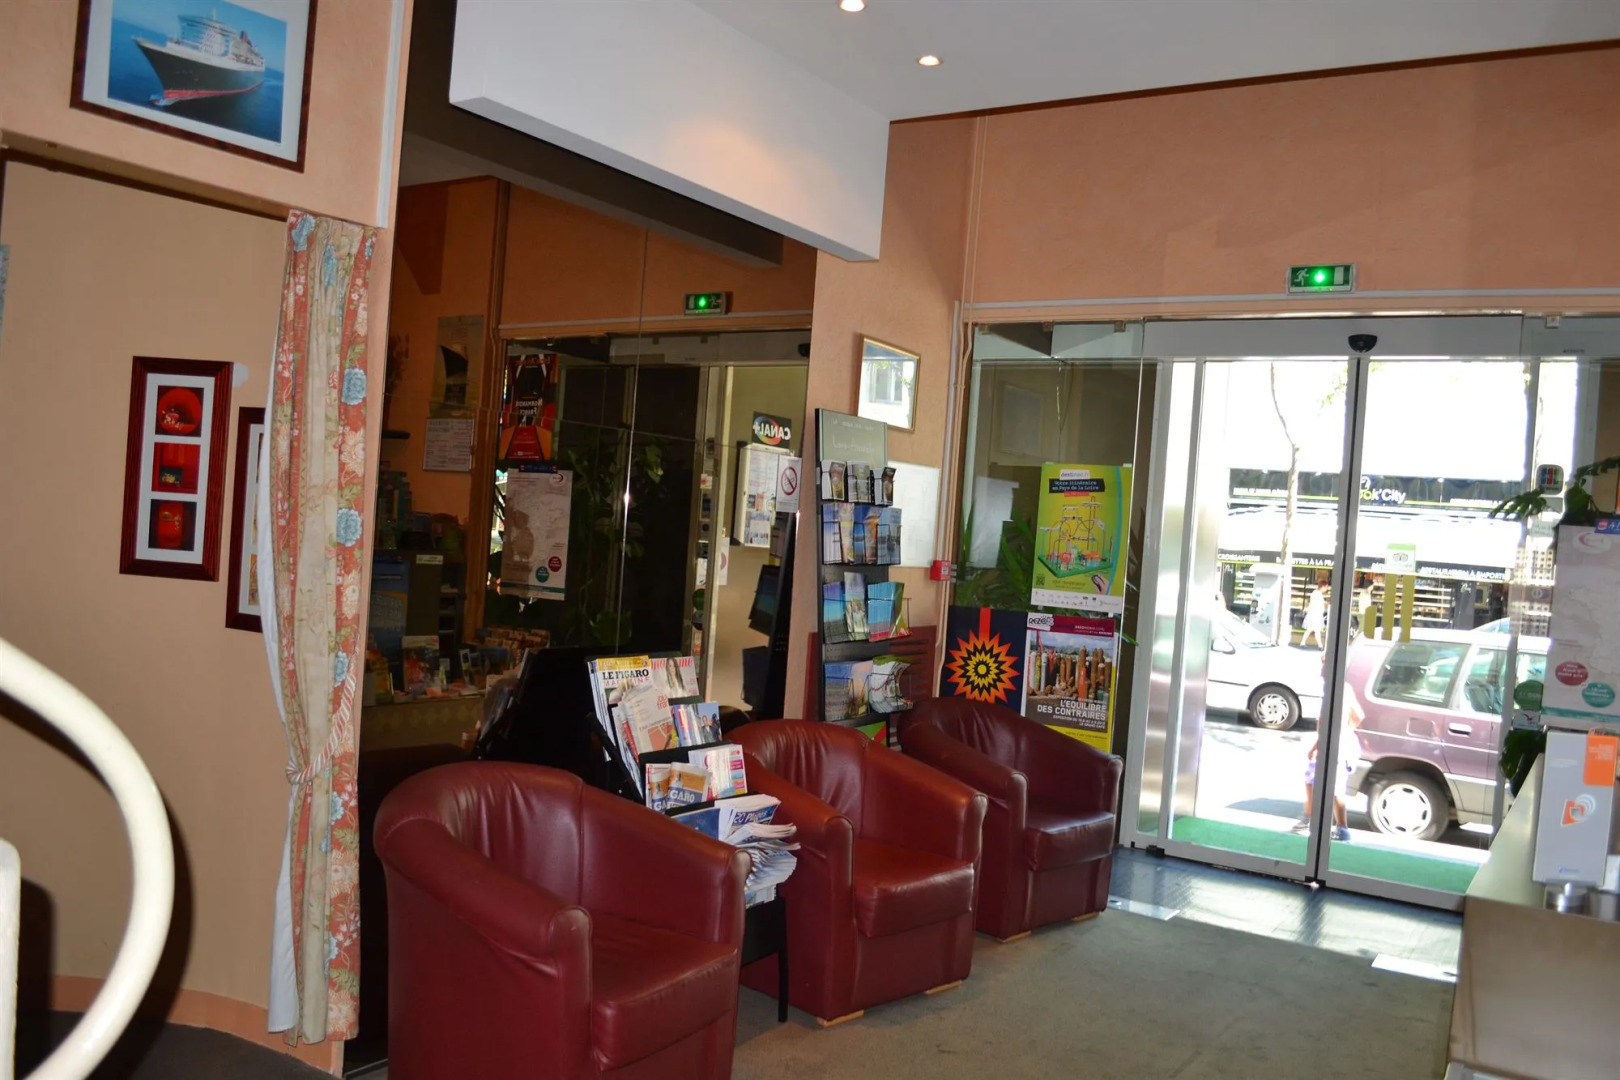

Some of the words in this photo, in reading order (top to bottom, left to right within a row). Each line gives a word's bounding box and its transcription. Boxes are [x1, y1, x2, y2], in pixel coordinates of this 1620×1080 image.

[1359, 487, 1406, 504] ok'City
[602, 671, 614, 680] LE
[615, 668, 649, 679] FIGARO
[1037, 704, 1053, 714] DES
[1054, 707, 1106, 720] CONTRAIRES
[1060, 699, 1106, 712] L'EQUILIBRE
[668, 789, 695, 803] GARO
